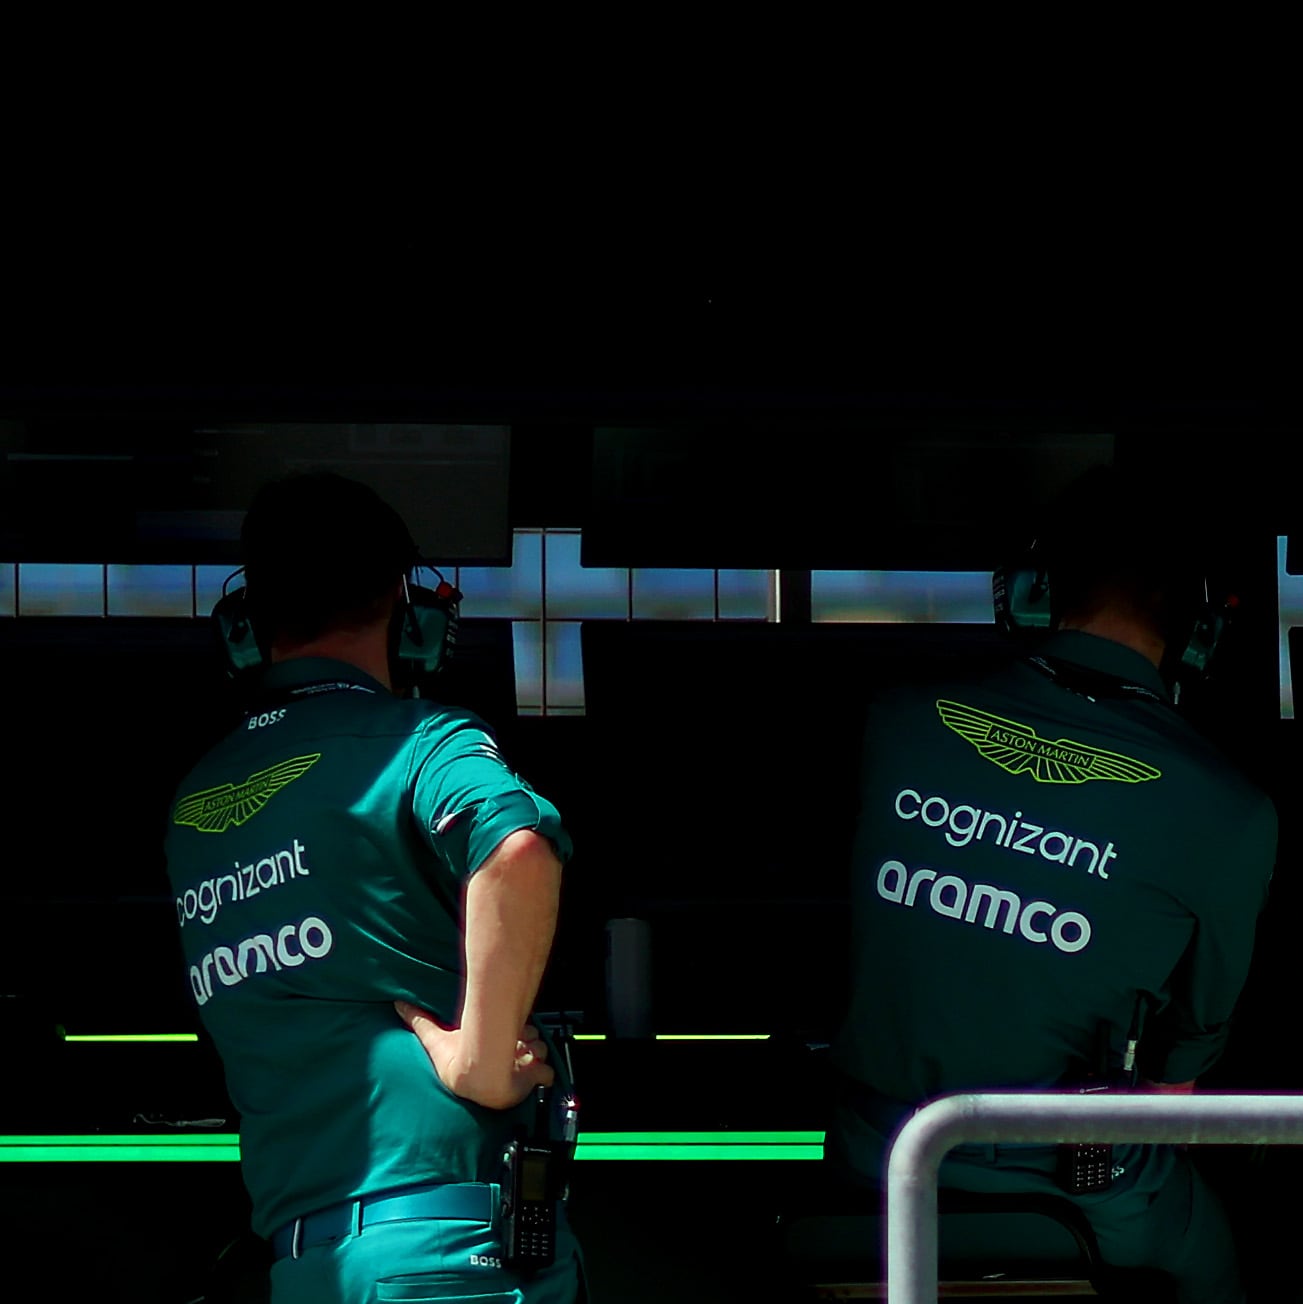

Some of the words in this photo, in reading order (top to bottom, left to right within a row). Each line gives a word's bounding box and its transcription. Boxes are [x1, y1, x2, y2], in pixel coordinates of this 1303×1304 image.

[247, 709, 287, 730] BOSS
[990, 729, 1038, 752] ASTON
[1037, 744, 1091, 767] MARTIN
[895, 789, 1118, 880] cognizant
[177, 839, 310, 925] cognizant
[876, 860, 1092, 953] aramco
[190, 916, 333, 1006] aramco
[470, 1254, 503, 1269] BOSS
